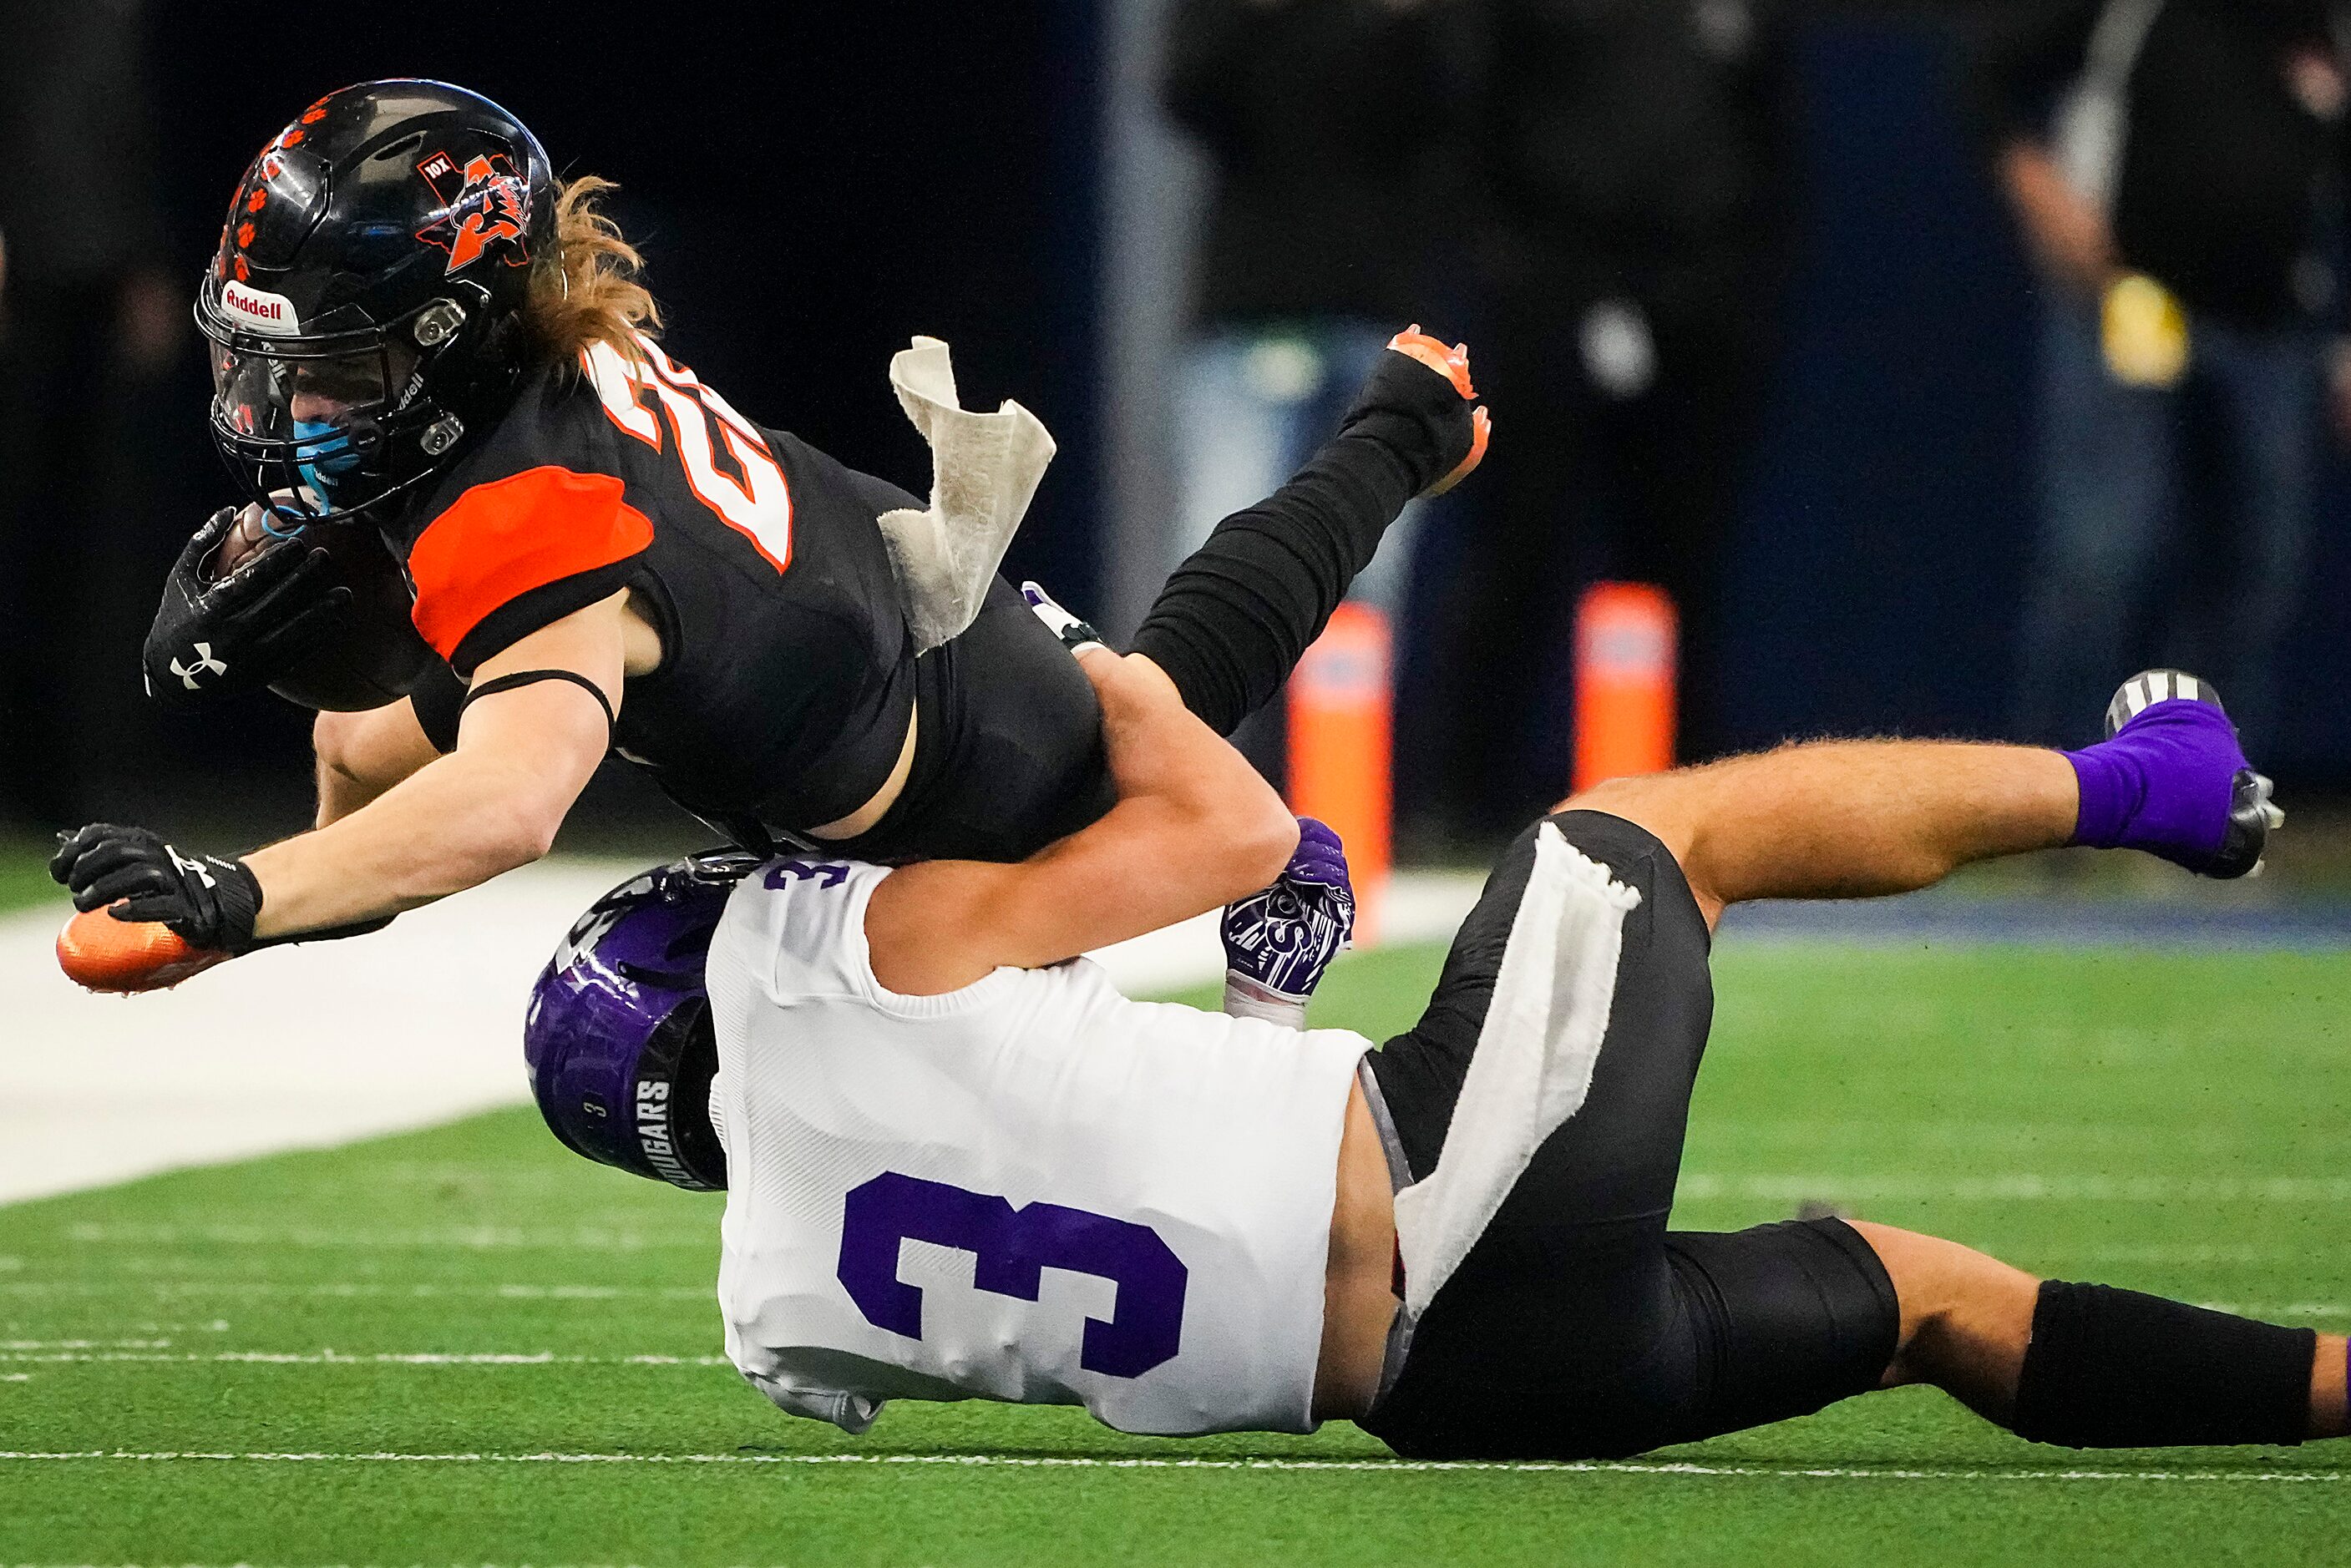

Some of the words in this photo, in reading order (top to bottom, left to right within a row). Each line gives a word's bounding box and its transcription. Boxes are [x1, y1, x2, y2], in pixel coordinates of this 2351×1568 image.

[423, 158, 452, 180] 10X
[226, 289, 281, 320] Riddell
[763, 861, 850, 890] 3
[583, 1102, 607, 1117] 3
[836, 1171, 1188, 1379] 3
